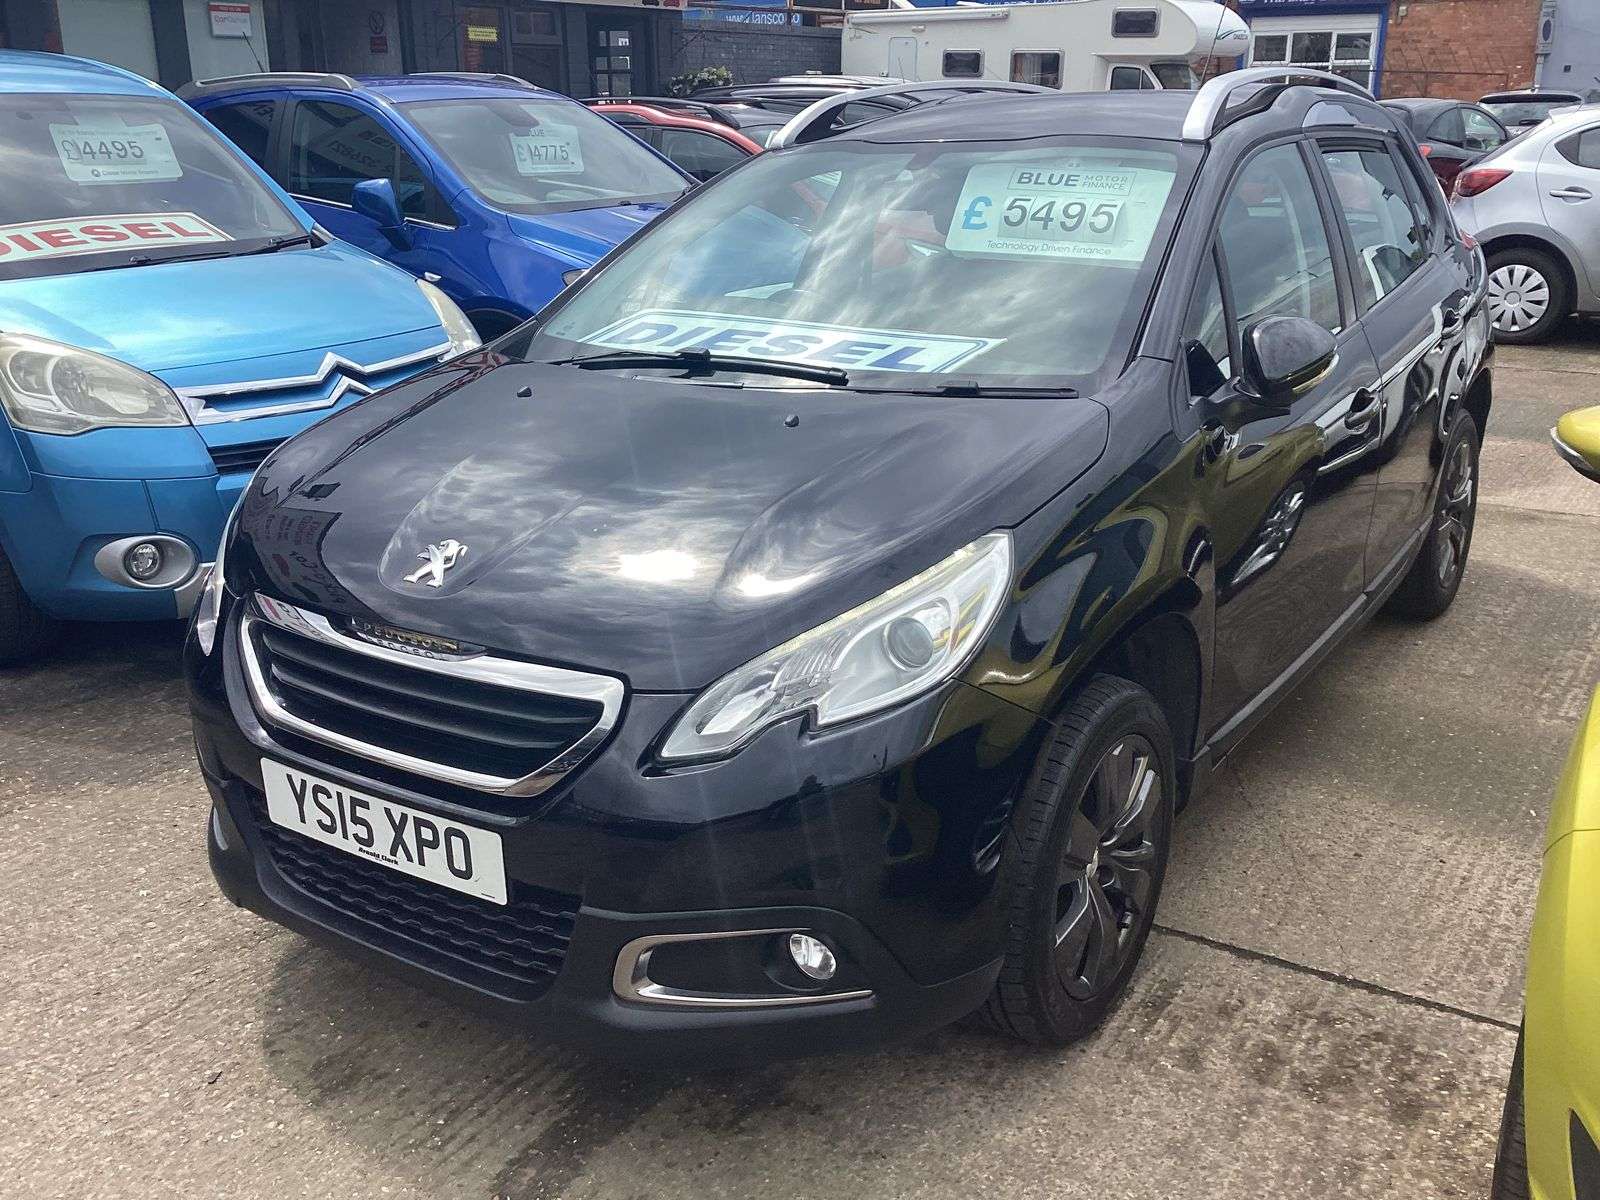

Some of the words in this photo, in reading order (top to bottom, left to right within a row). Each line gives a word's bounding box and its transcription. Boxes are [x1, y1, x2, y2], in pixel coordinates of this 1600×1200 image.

[1017, 171, 1081, 187] BLUE
[1085, 174, 1128, 182] MOTOR
[1082, 182, 1125, 190] FINANCE
[1003, 197, 1118, 234] 5495
[987, 240, 1039, 252] Technology
[1040, 243, 1071, 254] Driven
[1073, 246, 1112, 256] Finance
[600, 321, 935, 370] DIESEL
[286, 773, 375, 848] YS15
[383, 807, 473, 881] XPO
